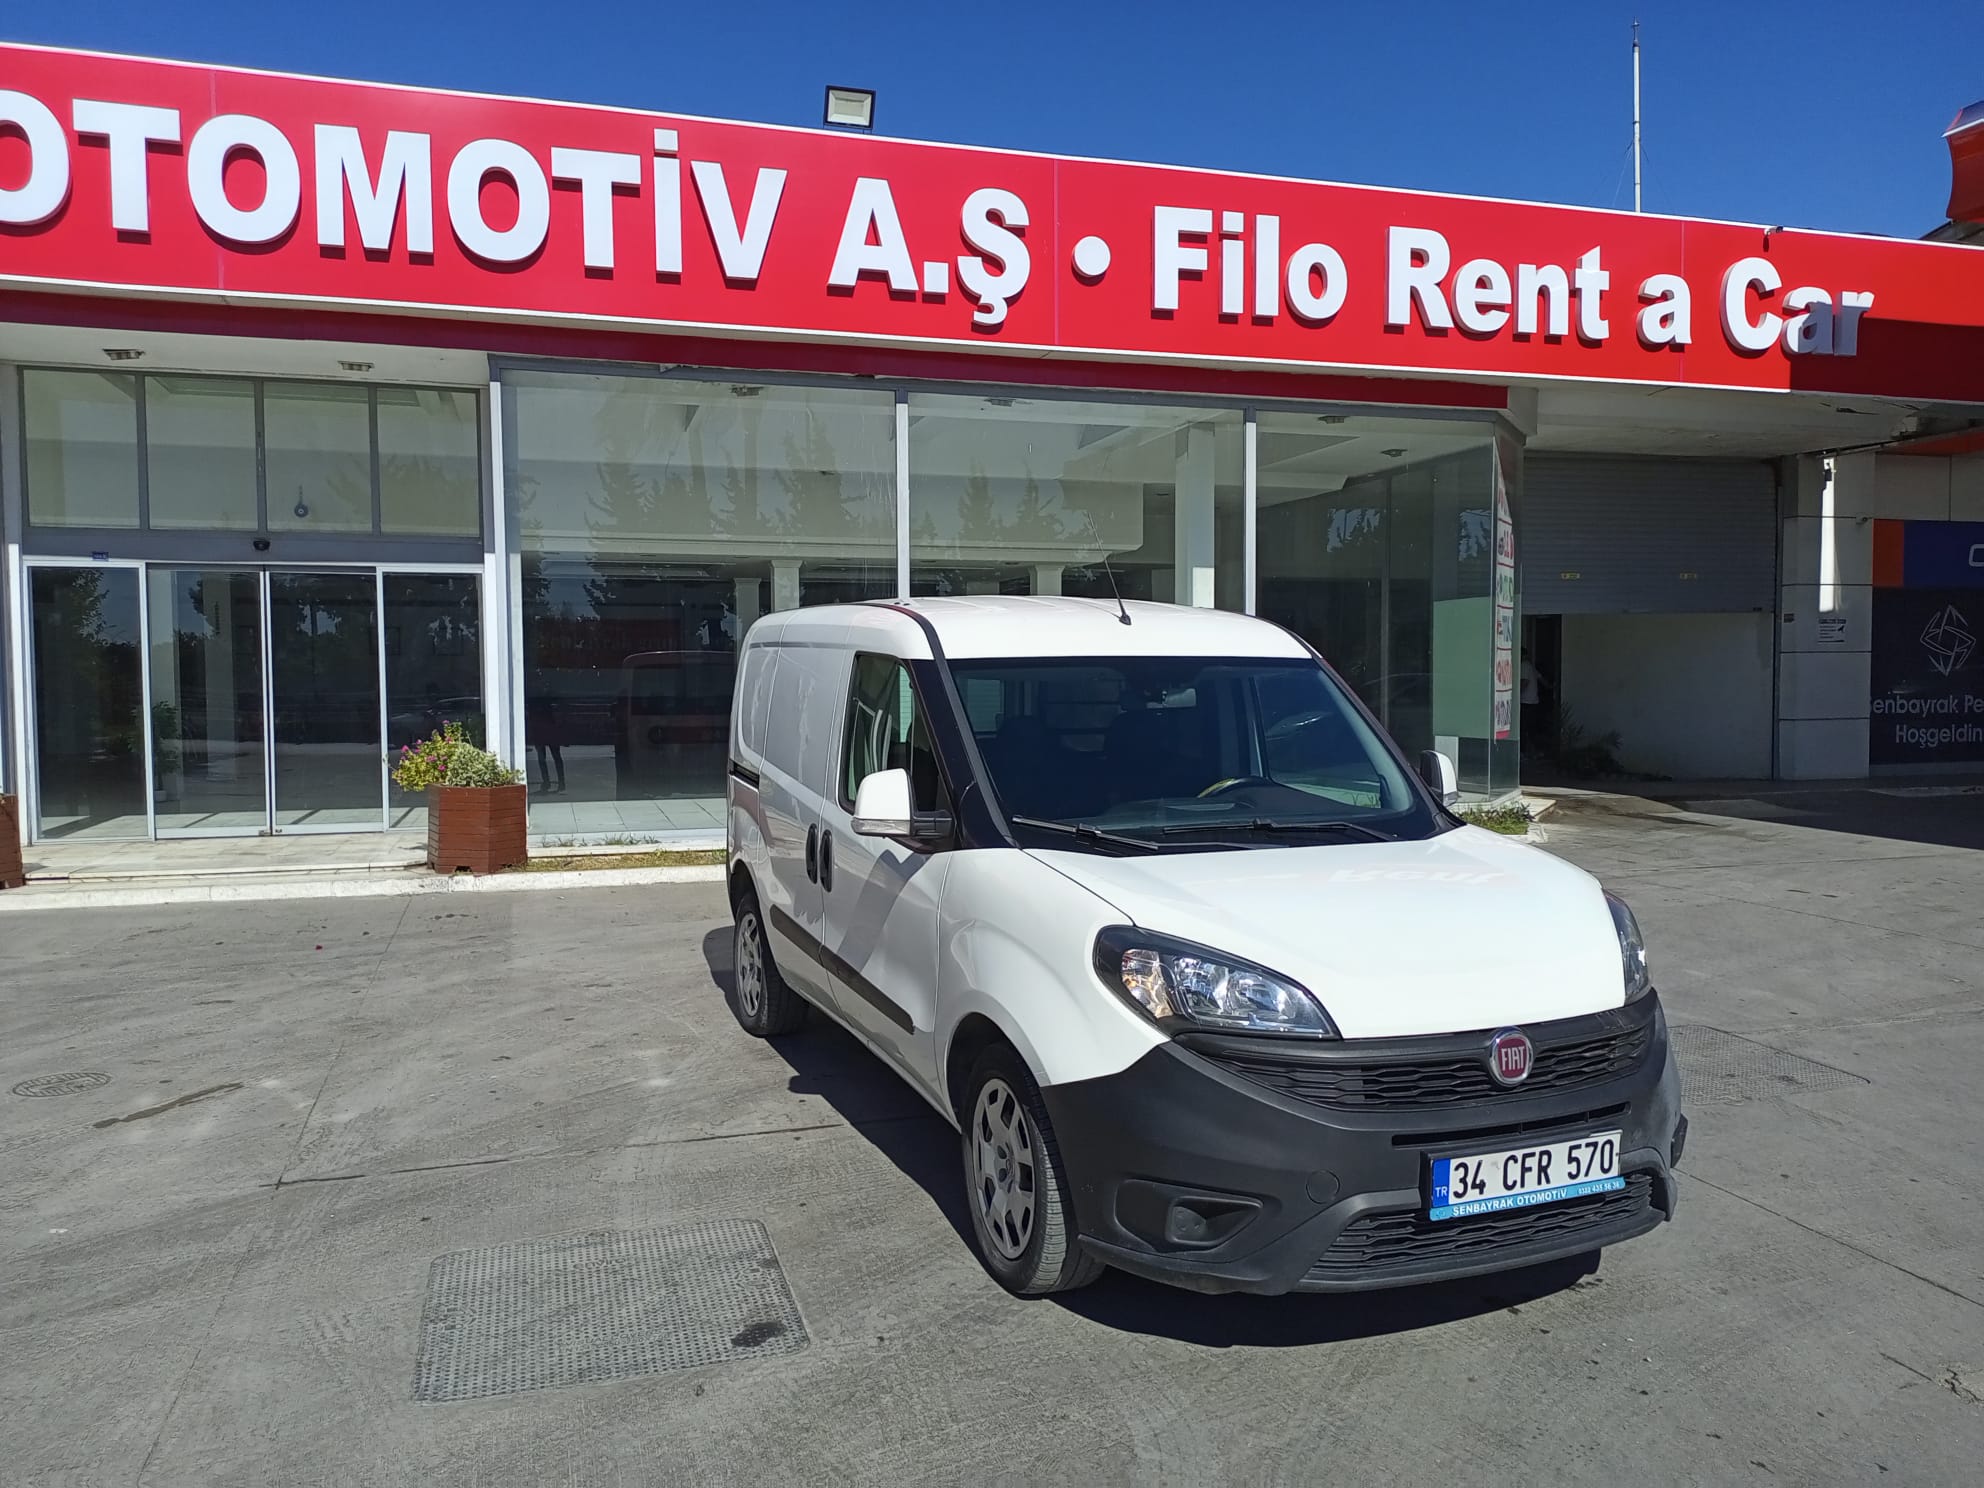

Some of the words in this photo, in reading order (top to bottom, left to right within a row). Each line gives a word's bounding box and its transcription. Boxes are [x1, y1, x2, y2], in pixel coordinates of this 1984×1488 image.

[0, 89, 787, 280] OTOMOTİV
[827, 177, 1031, 326] A.Ş
[1151, 204, 1347, 320] Filo
[1386, 225, 1610, 342] Rent
[1636, 273, 1693, 346] a
[1720, 256, 1875, 357] Car
[1870, 694, 1959, 717] enbayrak
[1501, 1046, 1525, 1071] FIAT
[1435, 1186, 1448, 1198] TR
[1453, 1159, 1486, 1198] 34
[1502, 1149, 1552, 1191] CFR
[1567, 1139, 1614, 1180] 570
[1453, 1198, 1514, 1217] SENBAYRAK
